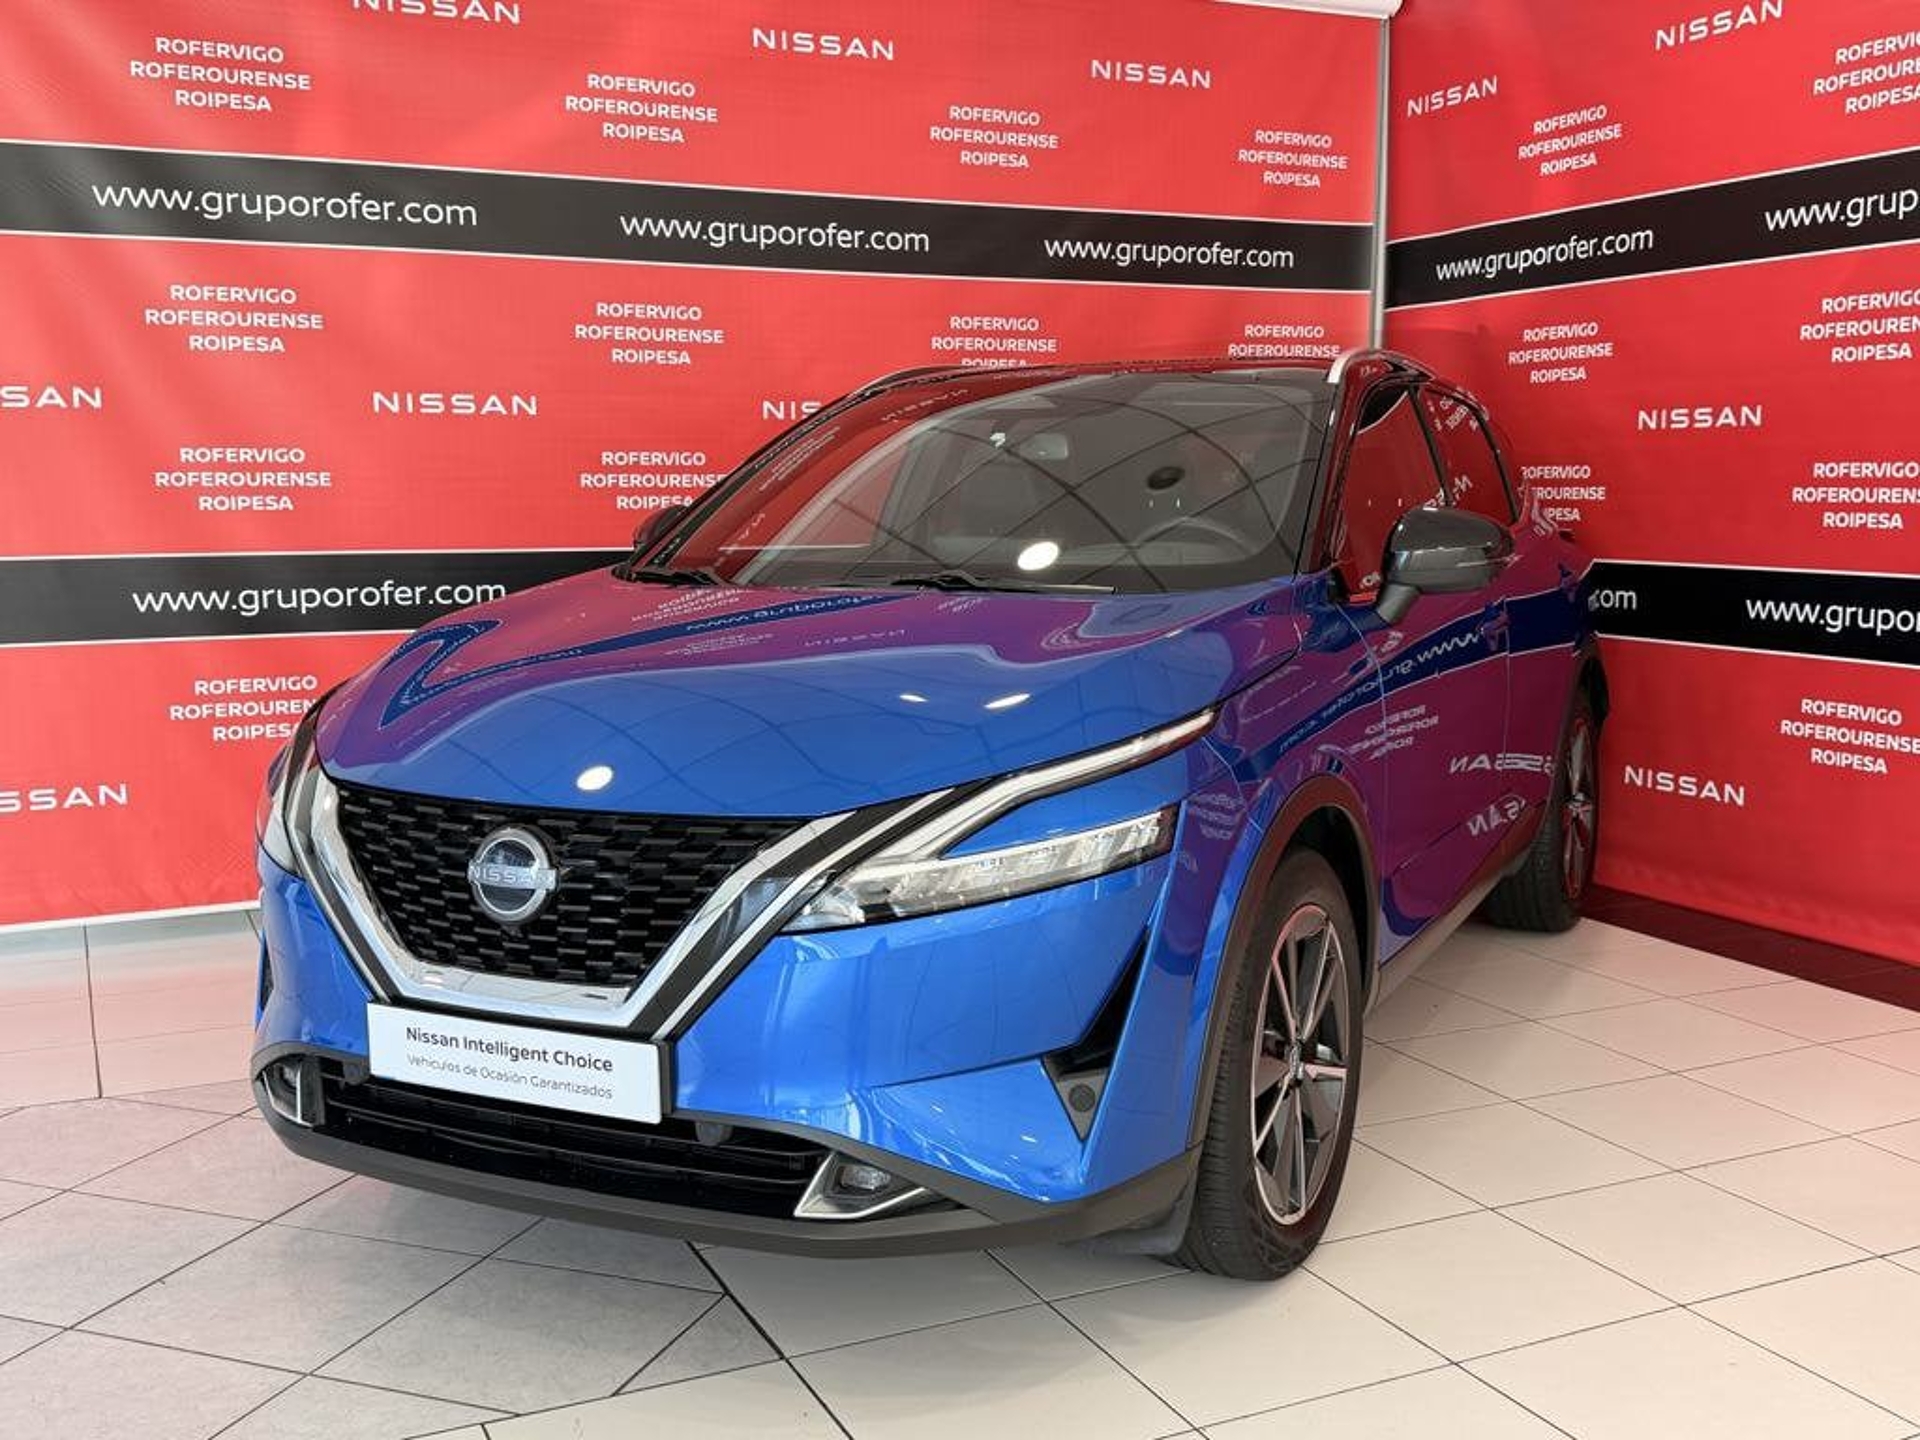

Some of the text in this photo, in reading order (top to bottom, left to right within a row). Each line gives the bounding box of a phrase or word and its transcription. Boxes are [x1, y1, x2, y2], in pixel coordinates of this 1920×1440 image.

[1656, 0, 1782, 49] NISSAN
[156, 37, 283, 62] ROFERVIGO
[753, 28, 893, 60] NISSAN
[130, 60, 310, 90] ROFEROURENSE
[1092, 60, 1210, 88] NISSAN
[588, 74, 695, 97] ROFERVIGO
[175, 90, 271, 111] ROIPESA
[1408, 76, 1497, 116] NISSAN
[566, 96, 717, 122] ROFEROURENSE
[950, 106, 1040, 125] ROFERVIGO
[1534, 105, 1607, 134] ROFERVIGO
[603, 122, 684, 142] ROIPESA
[930, 126, 1058, 148] ROFEROURENSE
[1255, 130, 1332, 148] ROFERVIGO
[1519, 124, 1621, 159] ROFEROURENSE
[961, 151, 1029, 167] ROIPESA
[1238, 149, 1347, 169] ROFEROURENSE
[1541, 152, 1597, 175] ROIPESA
[1264, 171, 1320, 187] ROIPESA
[92, 185, 476, 225] www.gruporofer.com
[620, 215, 929, 253] www.gruporofer.com
[1044, 240, 1293, 267] www.gruporofer.com
[1436, 230, 1653, 280] www.gruporofer.com
[170, 285, 296, 304] ROFERVIGO
[145, 309, 322, 328] ROFEROURENSE
[597, 303, 702, 321] ROFERVIGO
[950, 316, 1039, 331] ROFERVIGO
[1245, 325, 1324, 338] ROFERVIGO
[1524, 322, 1598, 341] ROFERVIGO
[189, 335, 284, 352] ROIPESA
[575, 325, 724, 344] ROFEROURENSE
[932, 337, 1056, 352] ROFEROURENSE
[612, 349, 690, 364] ROIPESA
[1228, 344, 1340, 357] ROFEROURENSE
[1509, 343, 1613, 363] ROFEROURENSE
[1832, 343, 1912, 362] ROIPESA
[1530, 367, 1586, 383] ROIPESA
[0, 386, 101, 408] SAN
[373, 392, 536, 415] NISSAN
[1639, 405, 1761, 429] NISSAN
[180, 448, 305, 463] ROFERVIGO
[602, 452, 705, 465] ROFERVIGO
[156, 472, 331, 487] ROFEROURENSE
[1814, 462, 1920, 478] ROFERVIGO
[199, 496, 293, 510] ROIPESA
[1823, 512, 1903, 529] ROIPESA
[132, 580, 505, 616] www.gruporofer.com
[195, 675, 317, 695] ROFERVIGO
[1802, 699, 1902, 726] ROFERVIGO
[213, 723, 298, 741] ROIPES
[1781, 720, 1920, 754] ROFEROURENSE
[1811, 748, 1887, 773] ROIPESA
[1625, 766, 1744, 806] NISSAN
[406, 1027, 613, 1072] Nissan Intelligent Choice
[463, 1065, 478, 1077] de
[530, 1076, 612, 1099] Garantizados
